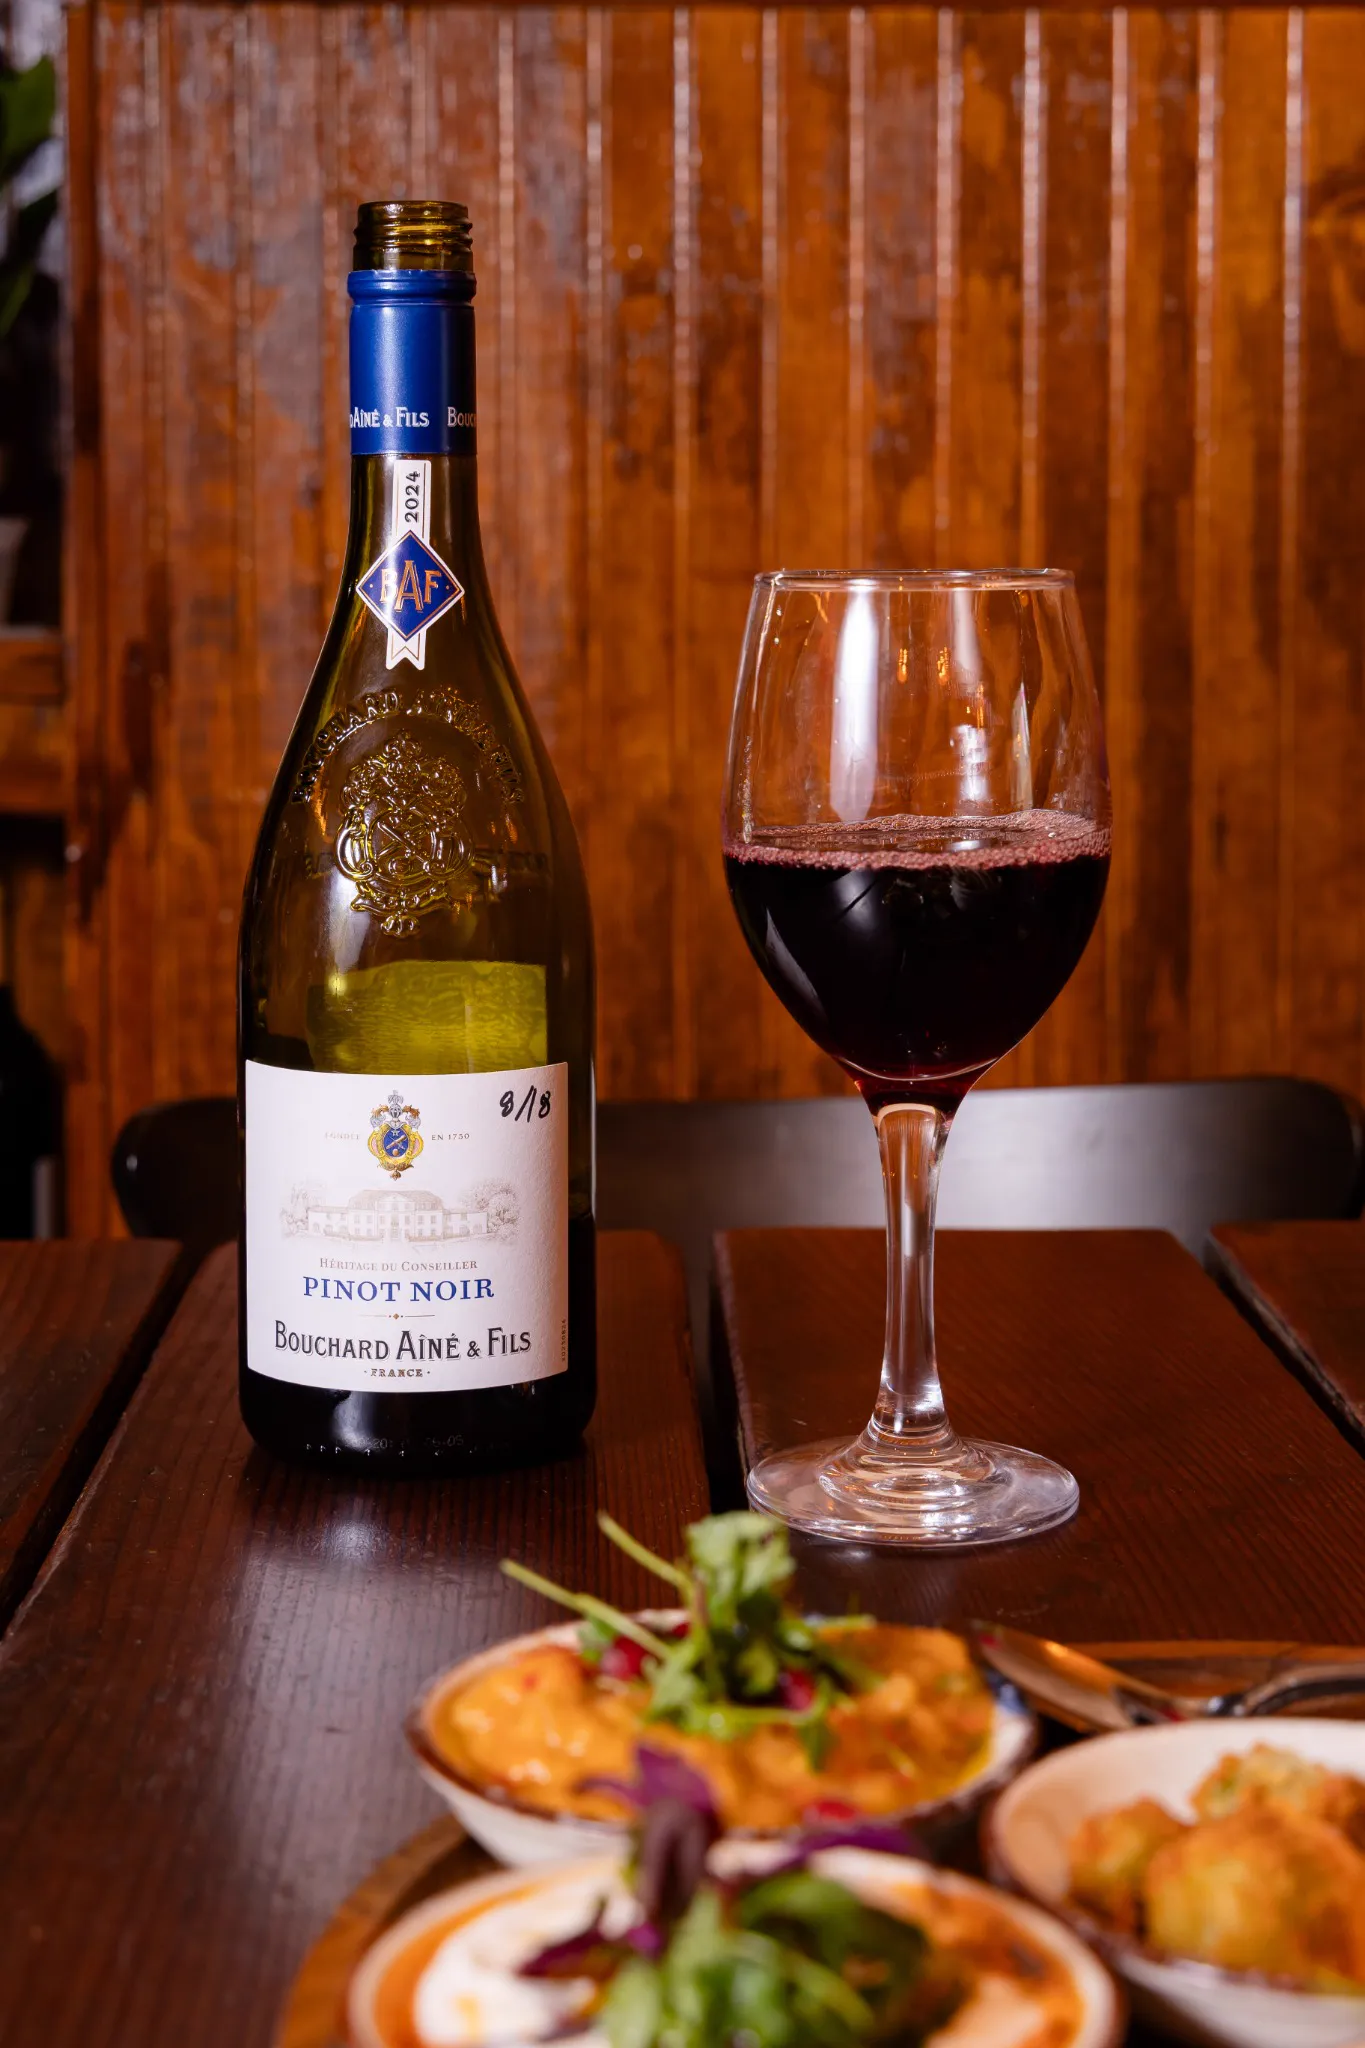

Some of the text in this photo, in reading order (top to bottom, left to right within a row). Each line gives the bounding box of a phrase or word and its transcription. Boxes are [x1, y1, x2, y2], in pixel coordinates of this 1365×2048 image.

[382, 414, 393, 428] &
[395, 406, 430, 428] FILS
[447, 406, 476, 428] BOUC
[404, 470, 420, 523] 2024
[380, 560, 442, 613] BAF
[499, 1084, 551, 1123] 8/18
[448, 1133, 470, 1141] 1750
[319, 1257, 478, 1272] HÉRITAGE DU CONSEILLER
[303, 1276, 495, 1302] PINOT NOIR
[274, 1320, 532, 1361] BOUCHARD AÎNÉ & FILS
